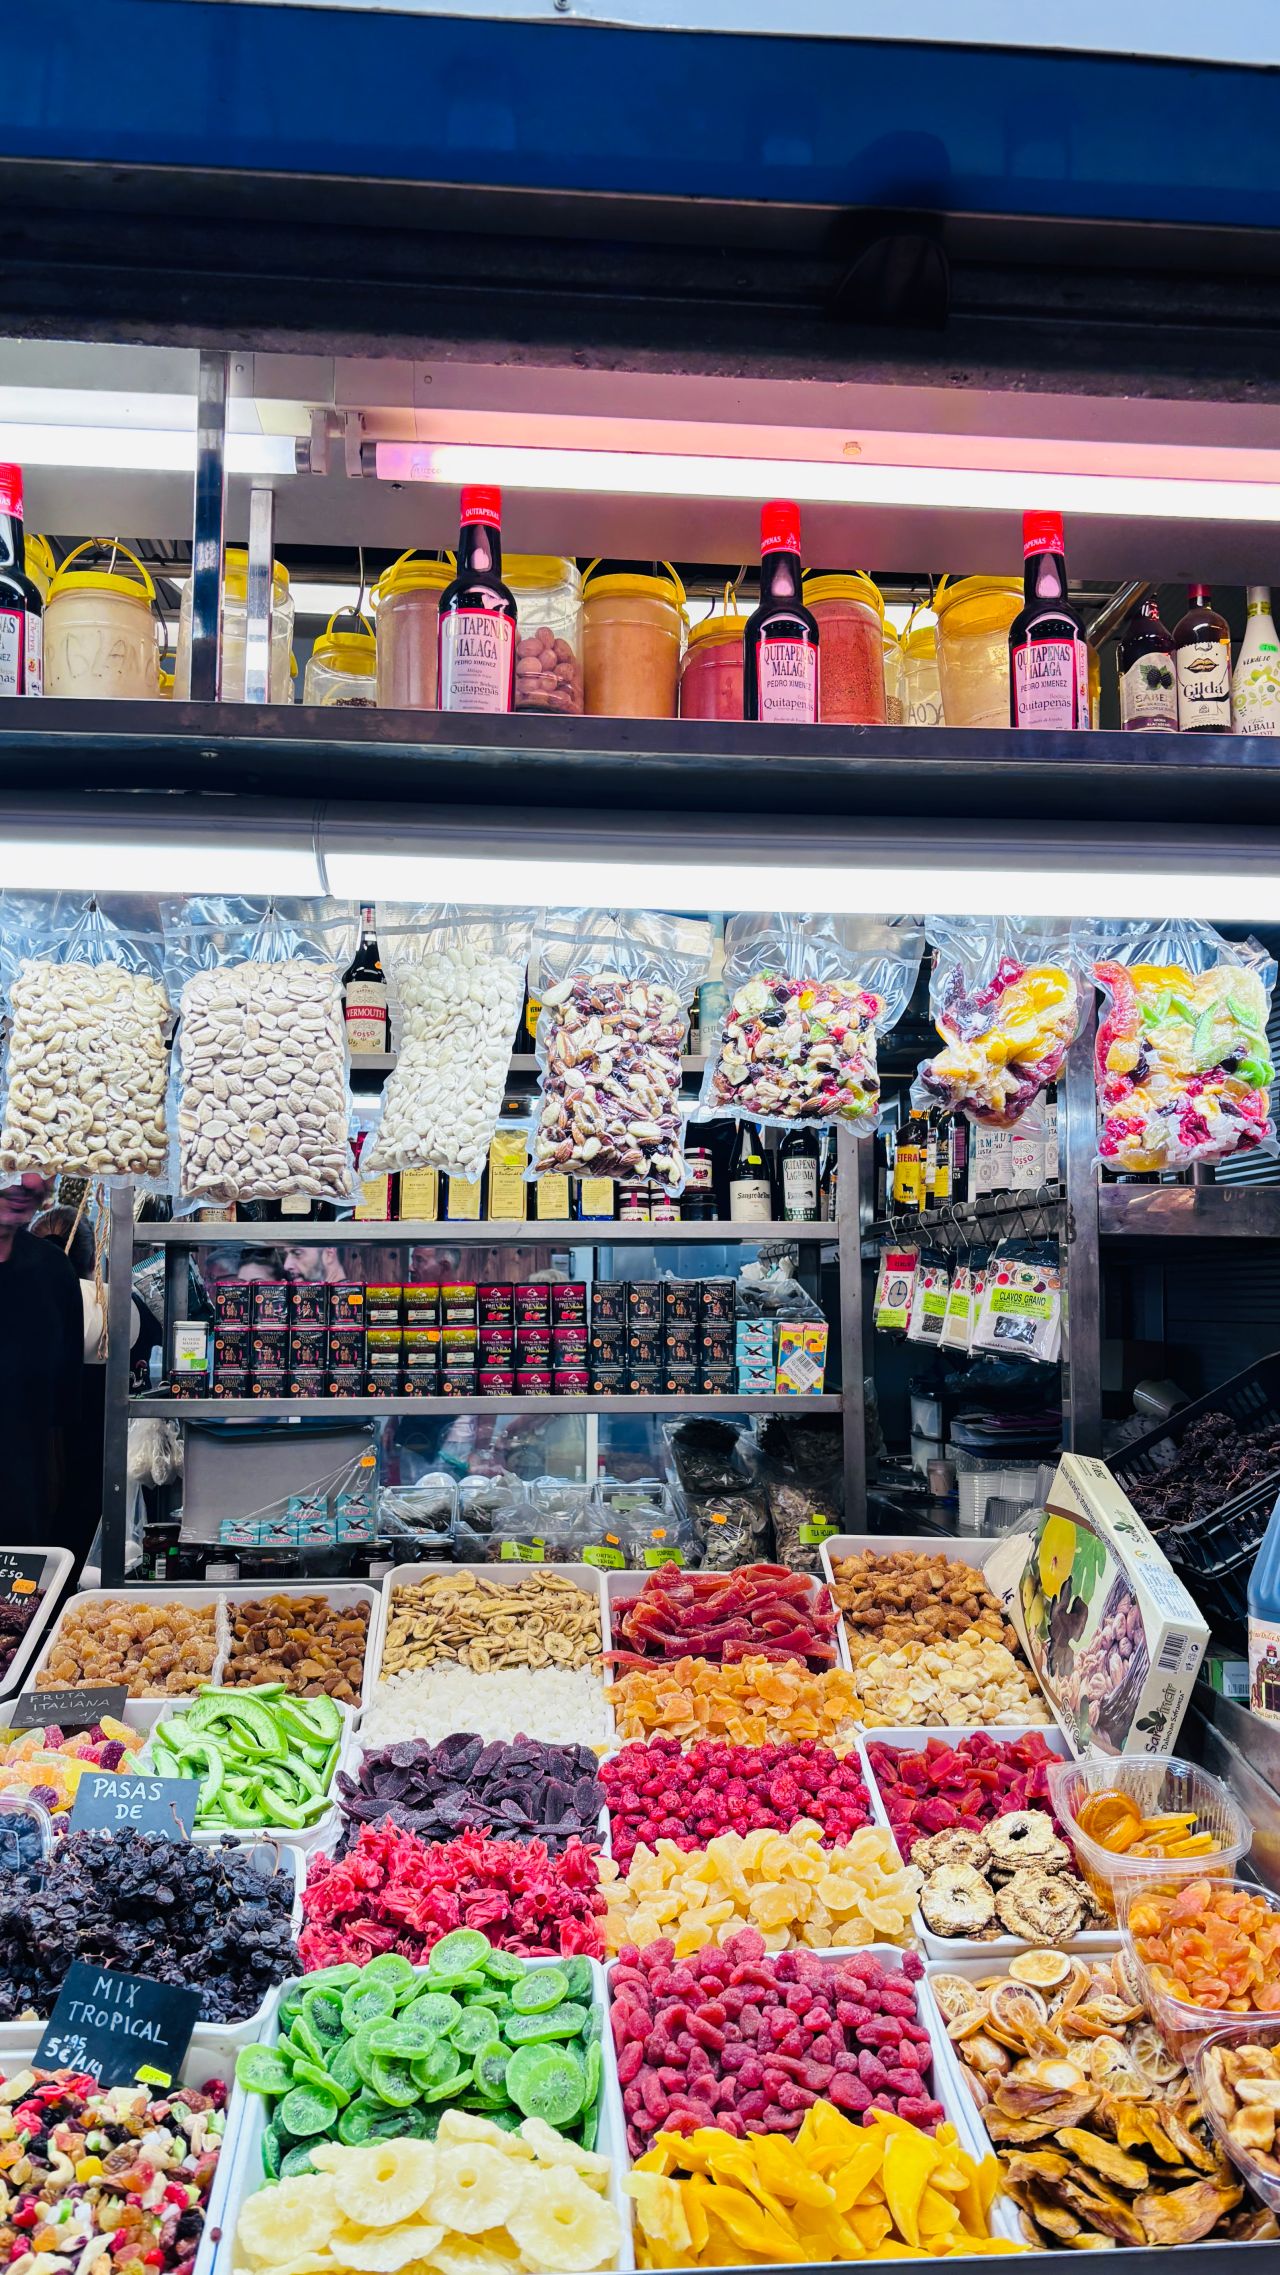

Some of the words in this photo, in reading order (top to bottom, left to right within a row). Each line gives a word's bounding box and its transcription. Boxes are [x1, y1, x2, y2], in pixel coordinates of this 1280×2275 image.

[474, 660, 496, 668] XIMENEZ
[450, 684, 499, 696] Quitapenas
[767, 679, 788, 688] PEDRO
[1021, 681, 1040, 692] PEDRO
[1041, 680, 1068, 688] XIMENEZ
[1183, 681, 1224, 700] Gilda
[763, 698, 814, 712] Quitapenas
[1019, 699, 1071, 714] Quitapenas
[1241, 722, 1275, 735] ALBALI
[346, 1006, 385, 1019] VERMOUTH
[353, 1030, 375, 1038] ROSSO
[1000, 1291, 1022, 1303] CLAVOS
[1024, 1295, 1046, 1307] GRANO
[30, 1691, 86, 1703] FRUTA
[34, 1699, 110, 1711] ITALIANA
[1060, 1696, 1082, 1744] Sare
[1145, 1722, 1164, 1754] Sare
[93, 1778, 164, 1801] PASAS
[115, 1804, 143, 1819] DE
[92, 1976, 141, 2008] MIX
[68, 2001, 168, 2046] TROPICAL
